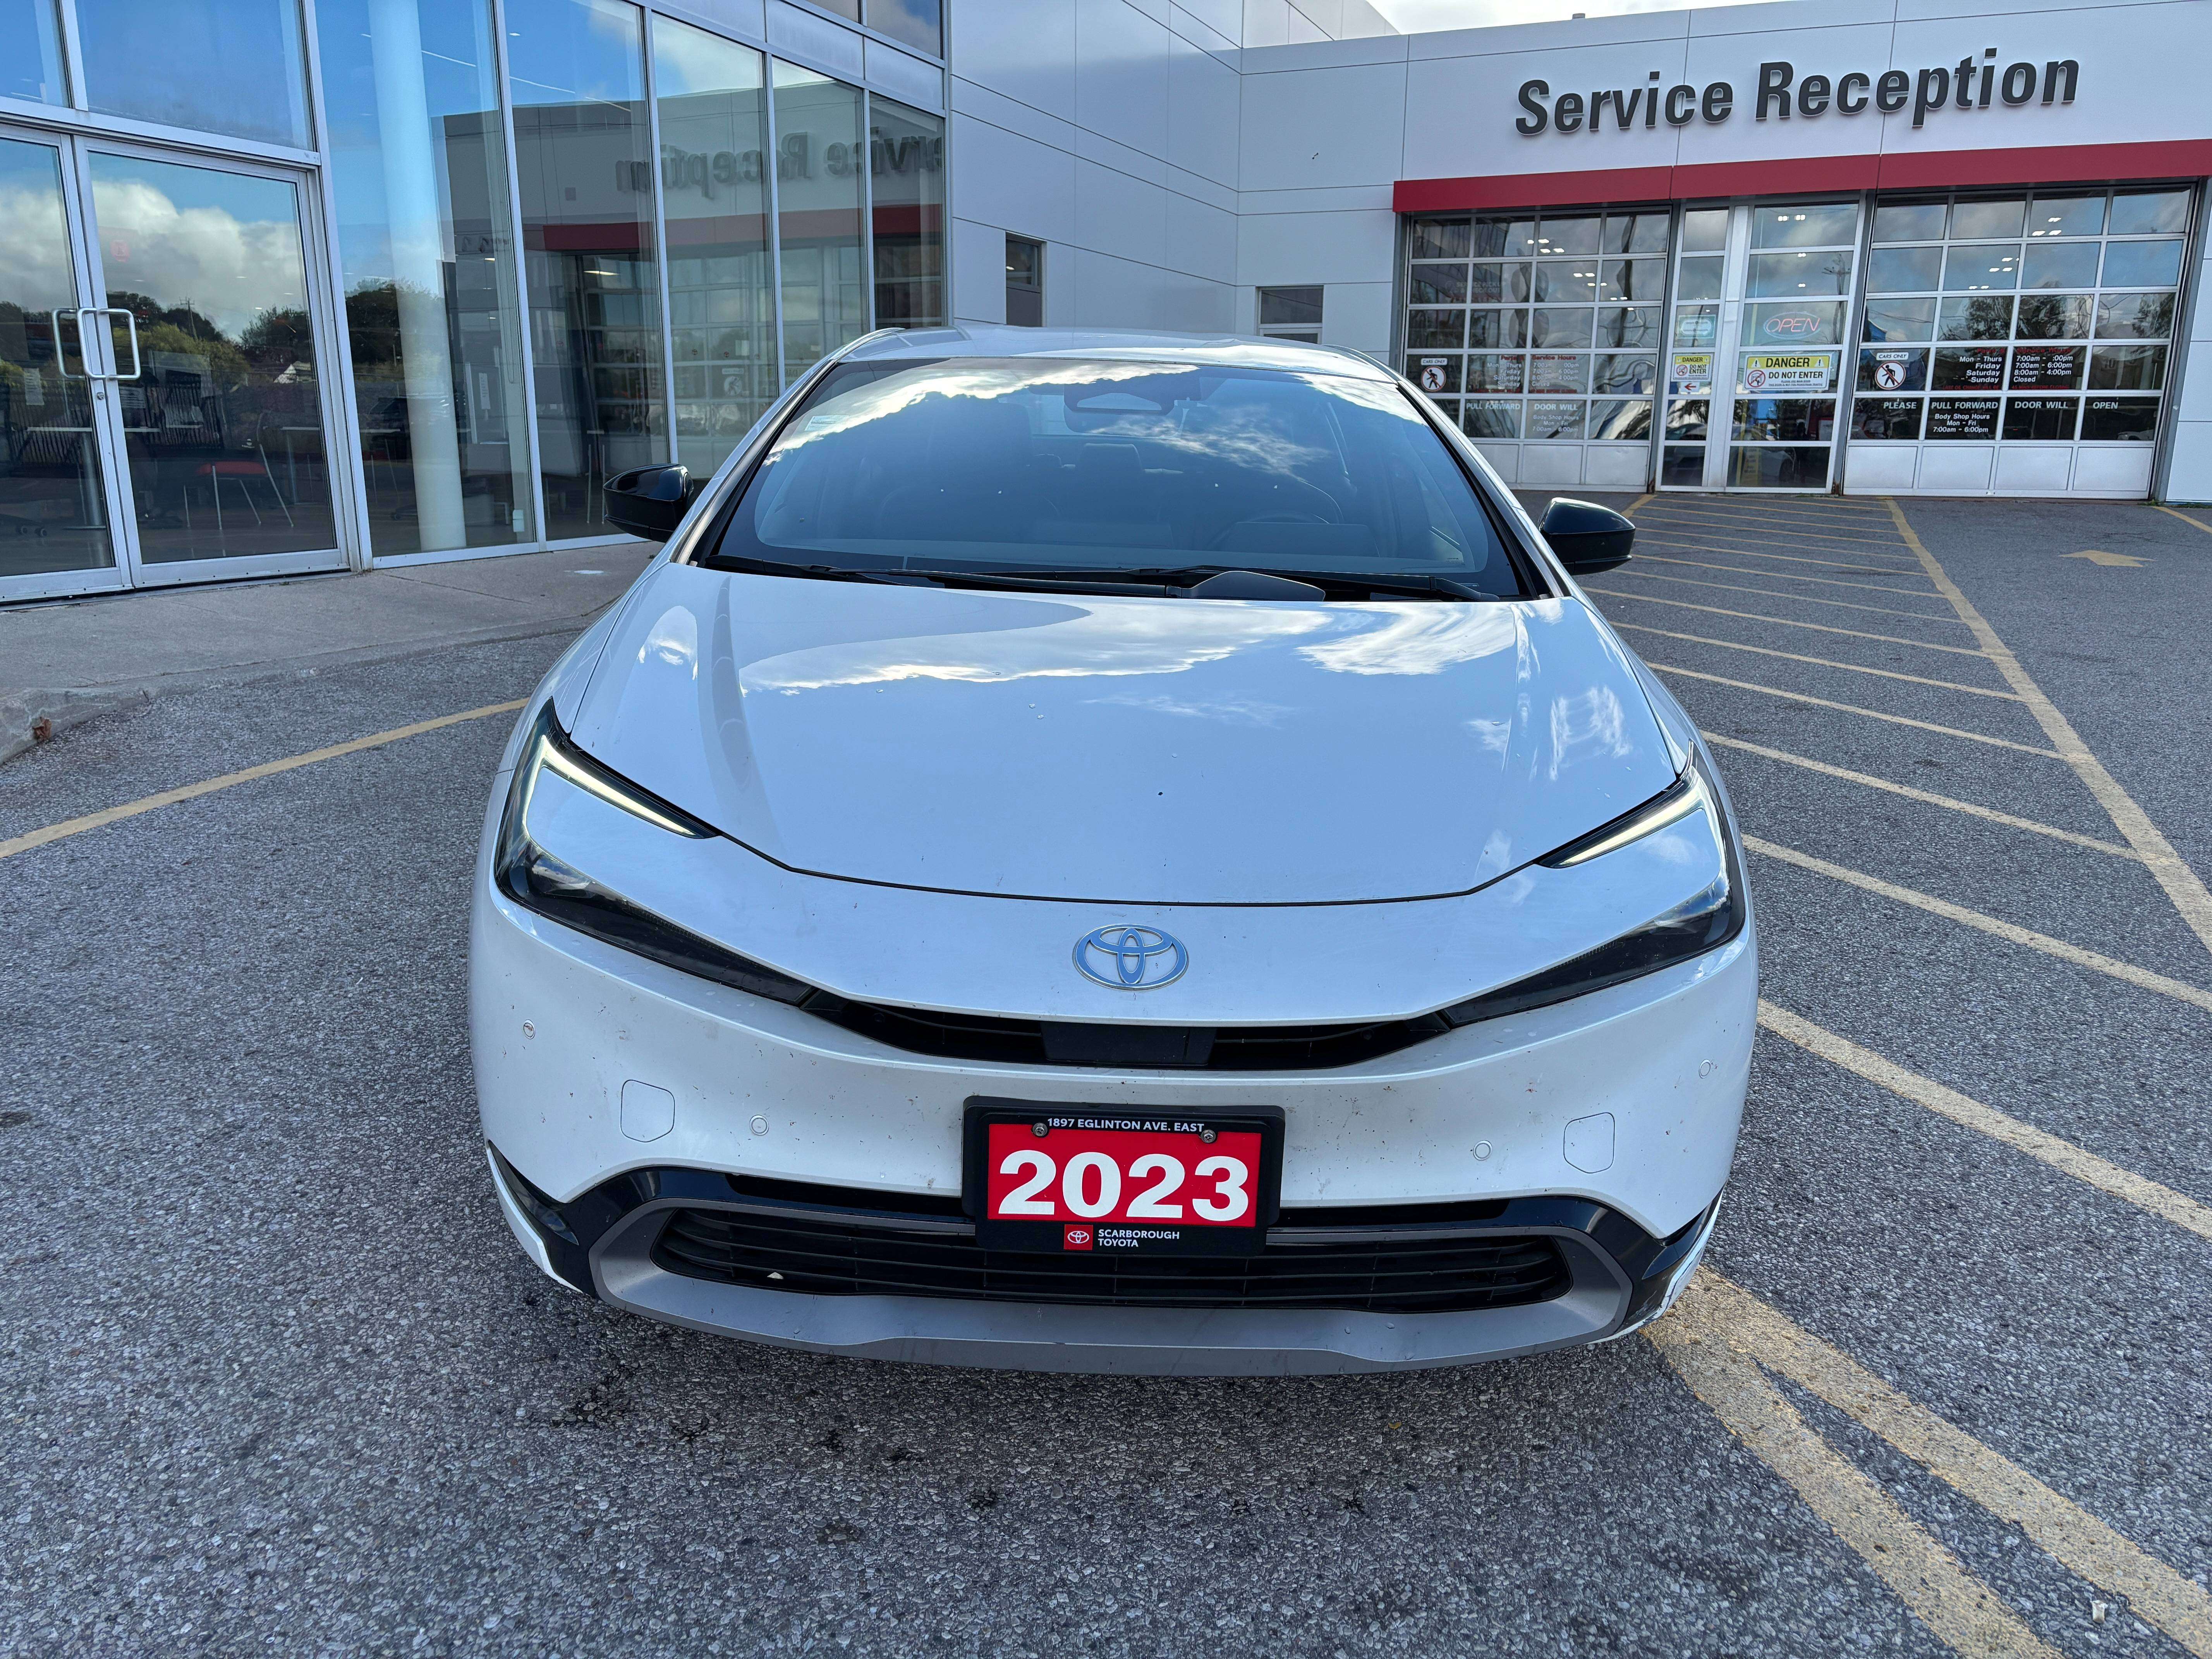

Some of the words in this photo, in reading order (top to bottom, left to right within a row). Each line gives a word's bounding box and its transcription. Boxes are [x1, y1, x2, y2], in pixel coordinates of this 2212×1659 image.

[1516, 71, 1733, 135] Service
[1755, 48, 2080, 129] Reception
[1766, 318, 1820, 332] OPEN
[1766, 358, 1810, 368] DANGER
[1048, 1118, 1074, 1127] 1897
[1078, 1119, 1140, 1130] EGLINTON
[1143, 1121, 1171, 1131] AVE.
[1174, 1123, 1204, 1132] EAST
[998, 1149, 1249, 1221] 2023
[1098, 1229, 1180, 1239] SCARBOROUGH
[1098, 1238, 1139, 1247] TOYOTA
